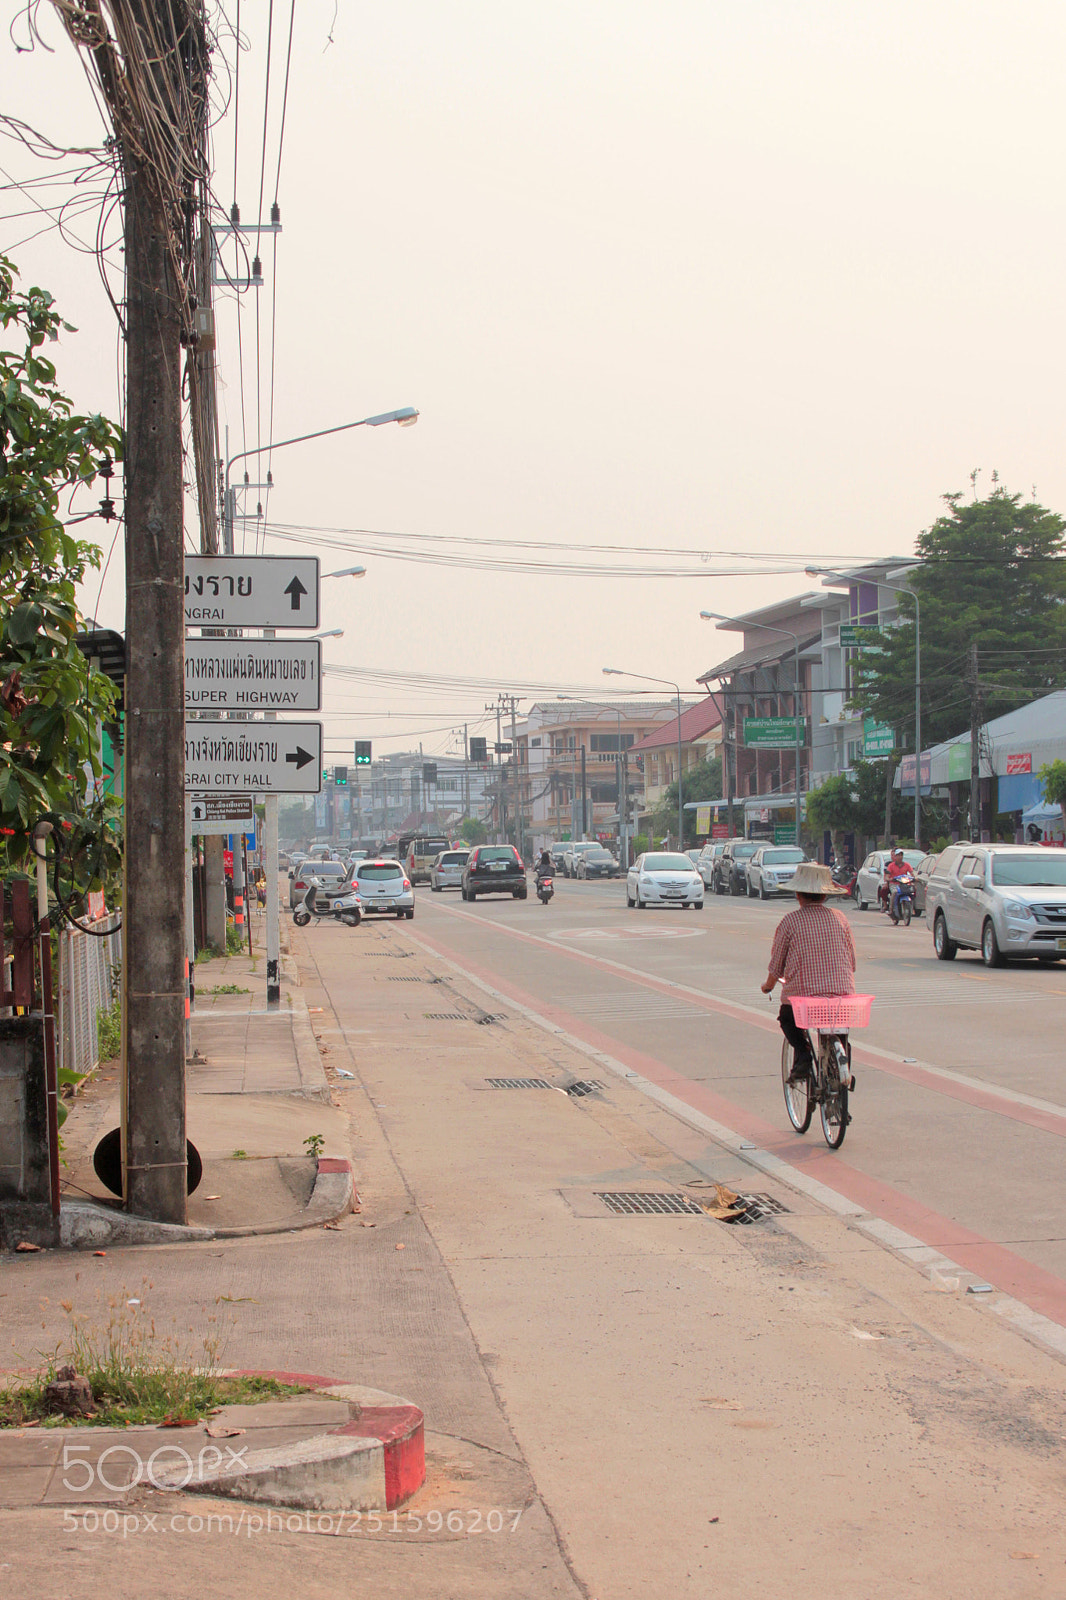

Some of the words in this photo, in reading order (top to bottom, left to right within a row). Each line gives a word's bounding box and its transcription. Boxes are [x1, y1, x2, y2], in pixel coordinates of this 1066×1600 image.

[185, 608, 225, 620] NGRAI
[310, 659, 314, 680] 1
[185, 690, 227, 702] SUPER
[236, 691, 299, 703] HIGHWAY
[185, 773, 210, 785] GRAI
[214, 774, 239, 785] CITY
[243, 774, 272, 785] HALL
